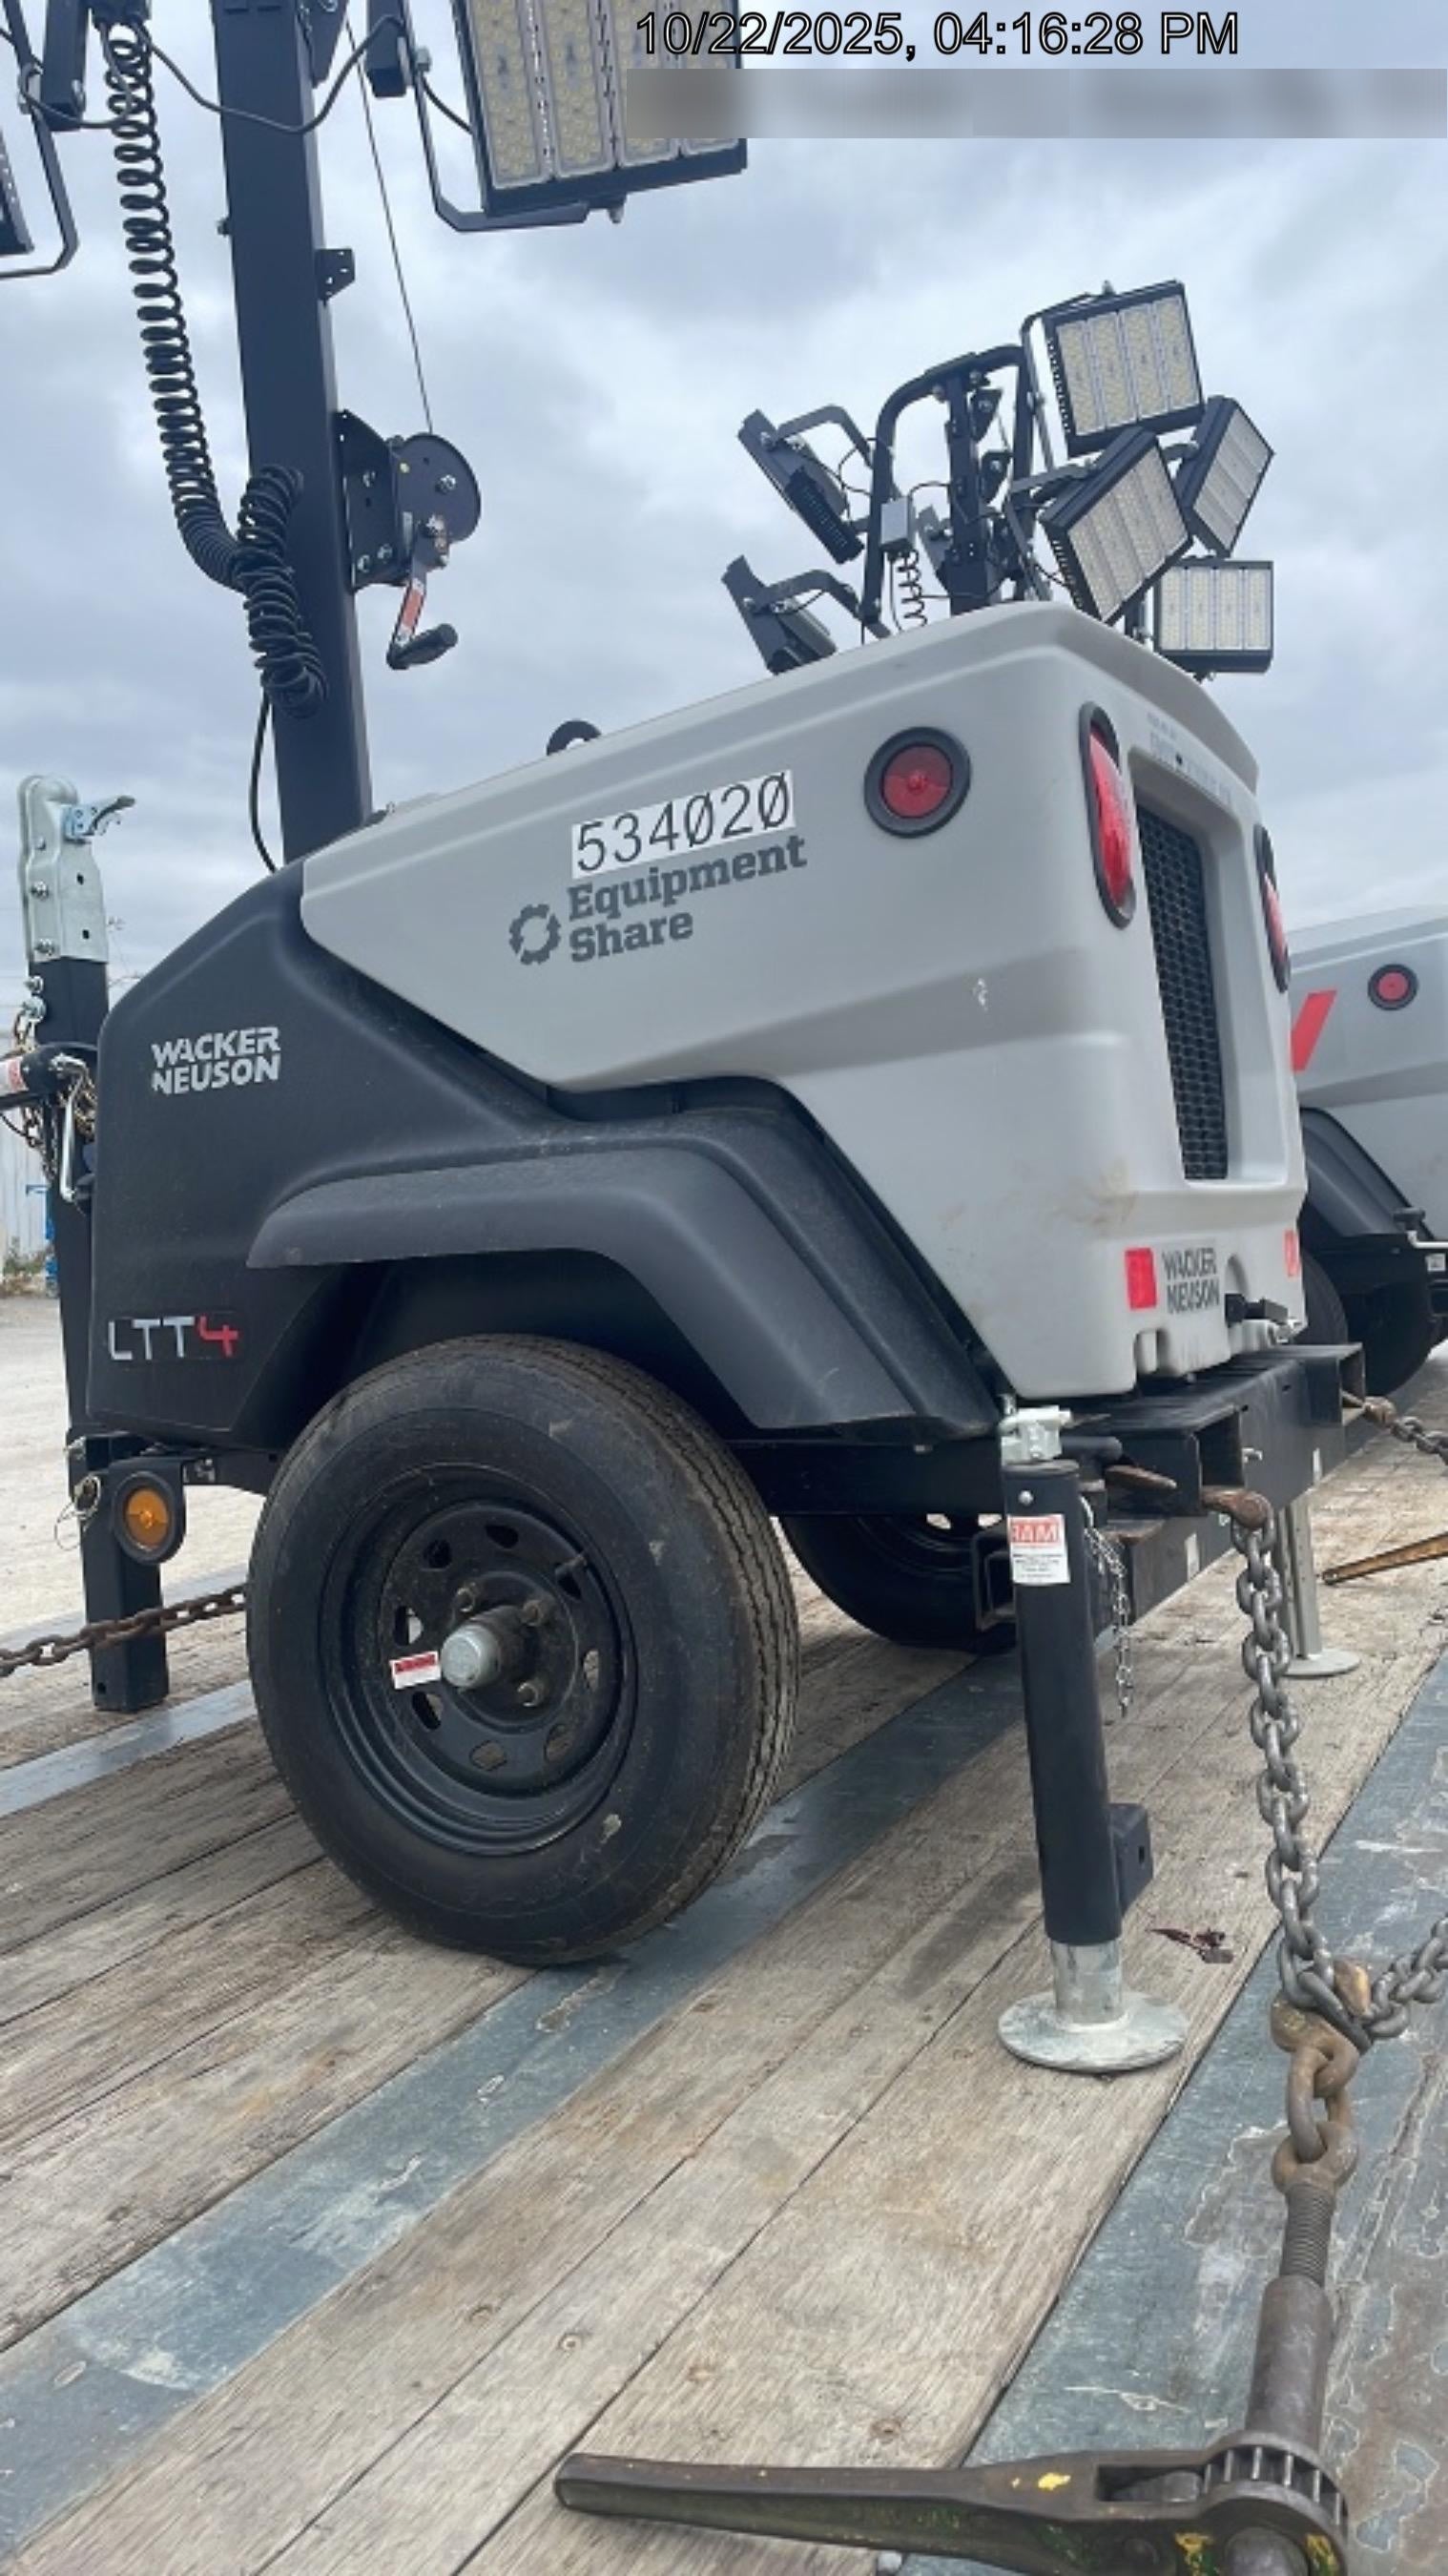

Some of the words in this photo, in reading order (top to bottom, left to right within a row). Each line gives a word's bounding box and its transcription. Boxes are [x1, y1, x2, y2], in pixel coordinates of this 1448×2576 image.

[577, 772, 790, 872] 534020
[567, 834, 809, 922] Equipment
[569, 911, 693, 963] Share
[151, 1027, 280, 1069] WACKER
[151, 1052, 280, 1095] NEUSON
[1161, 1247, 1216, 1280] WACKER
[108, 1316, 238, 1361] LTT4
